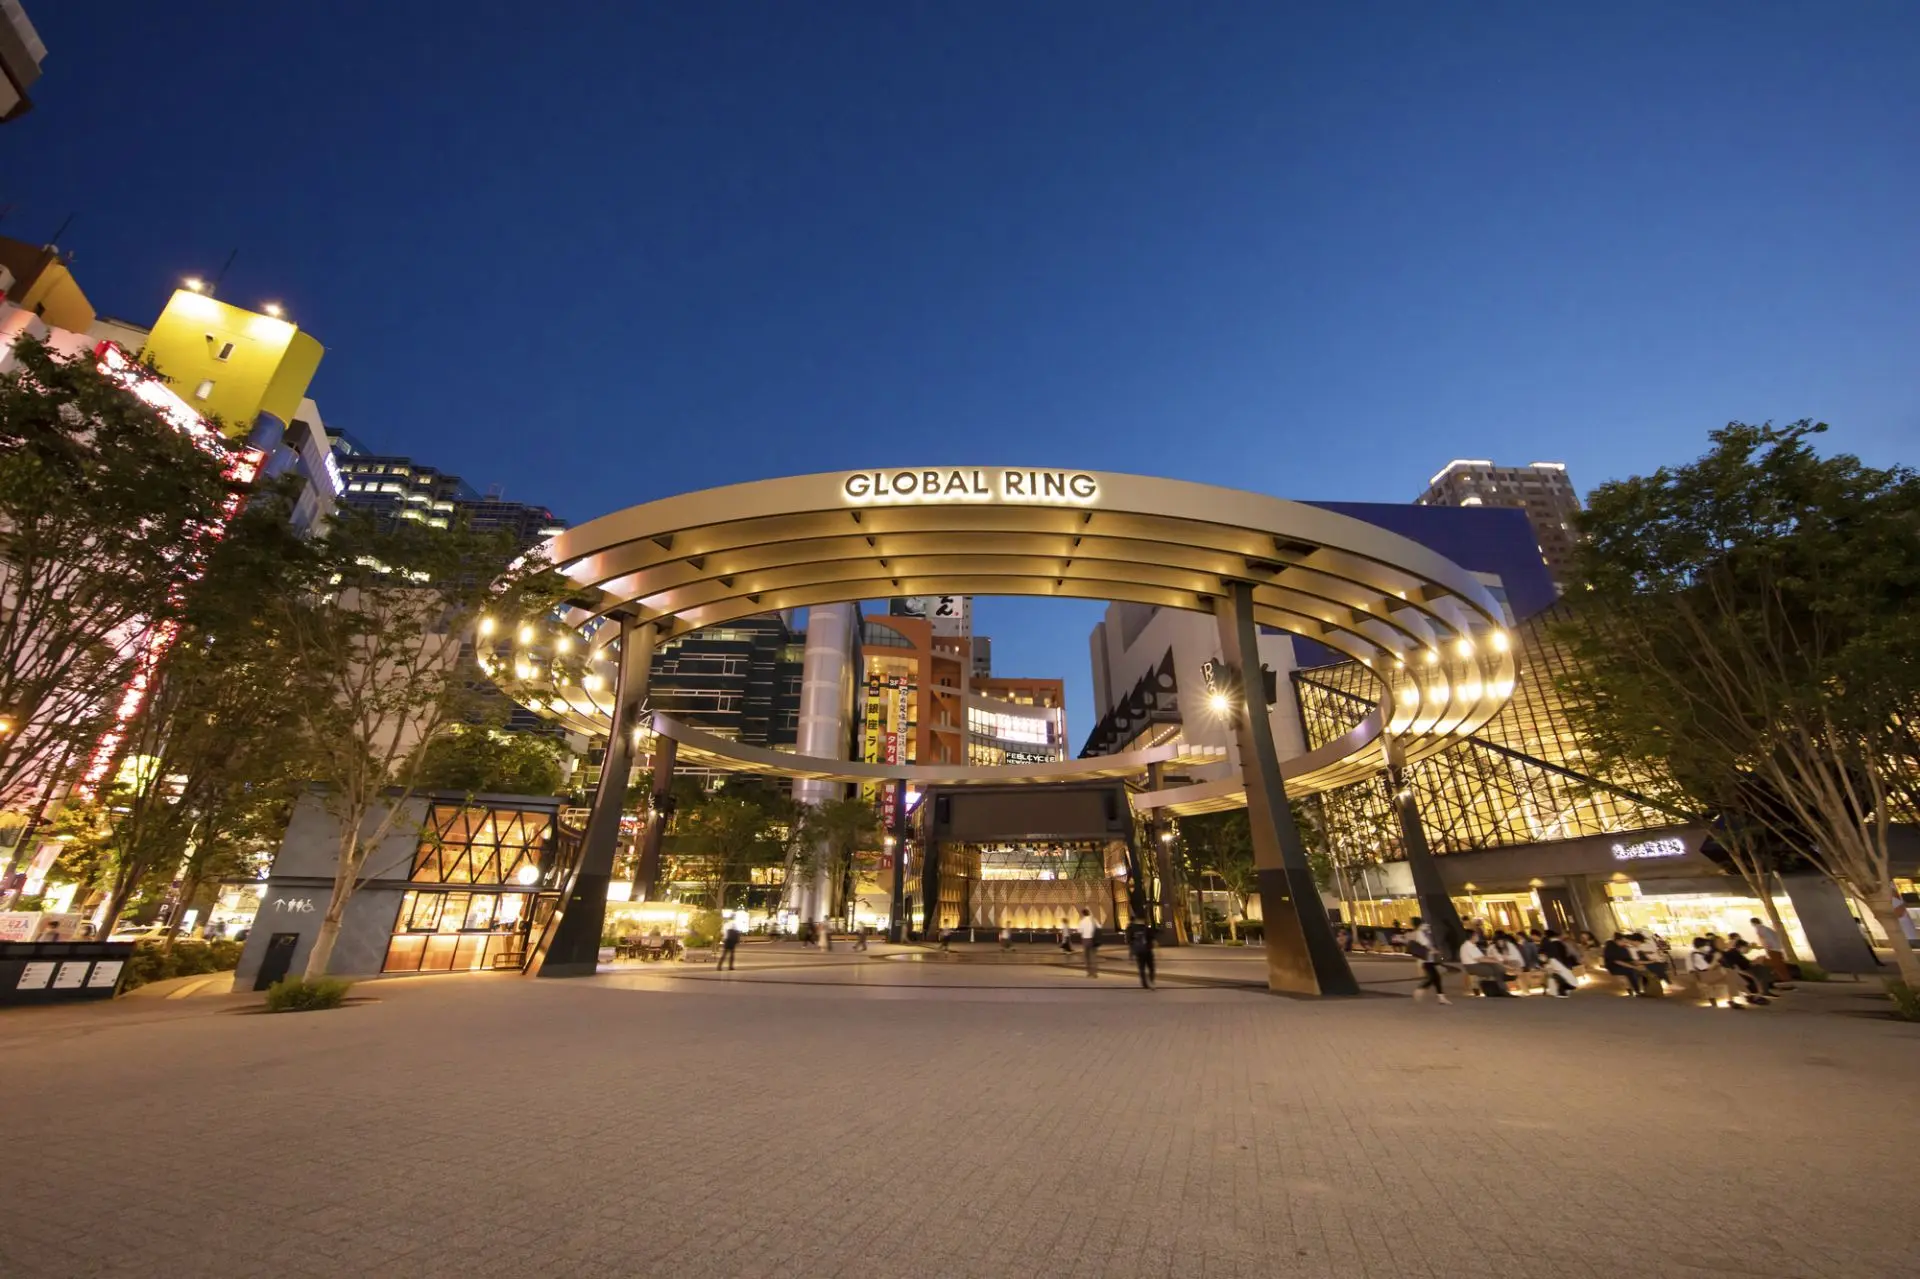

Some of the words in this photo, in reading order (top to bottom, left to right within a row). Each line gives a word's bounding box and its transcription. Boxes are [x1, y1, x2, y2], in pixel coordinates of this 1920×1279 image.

[844, 470, 989, 498] GLOBAL
[1005, 471, 1097, 499] RING
[865, 703, 879, 797] 銀座ライン
